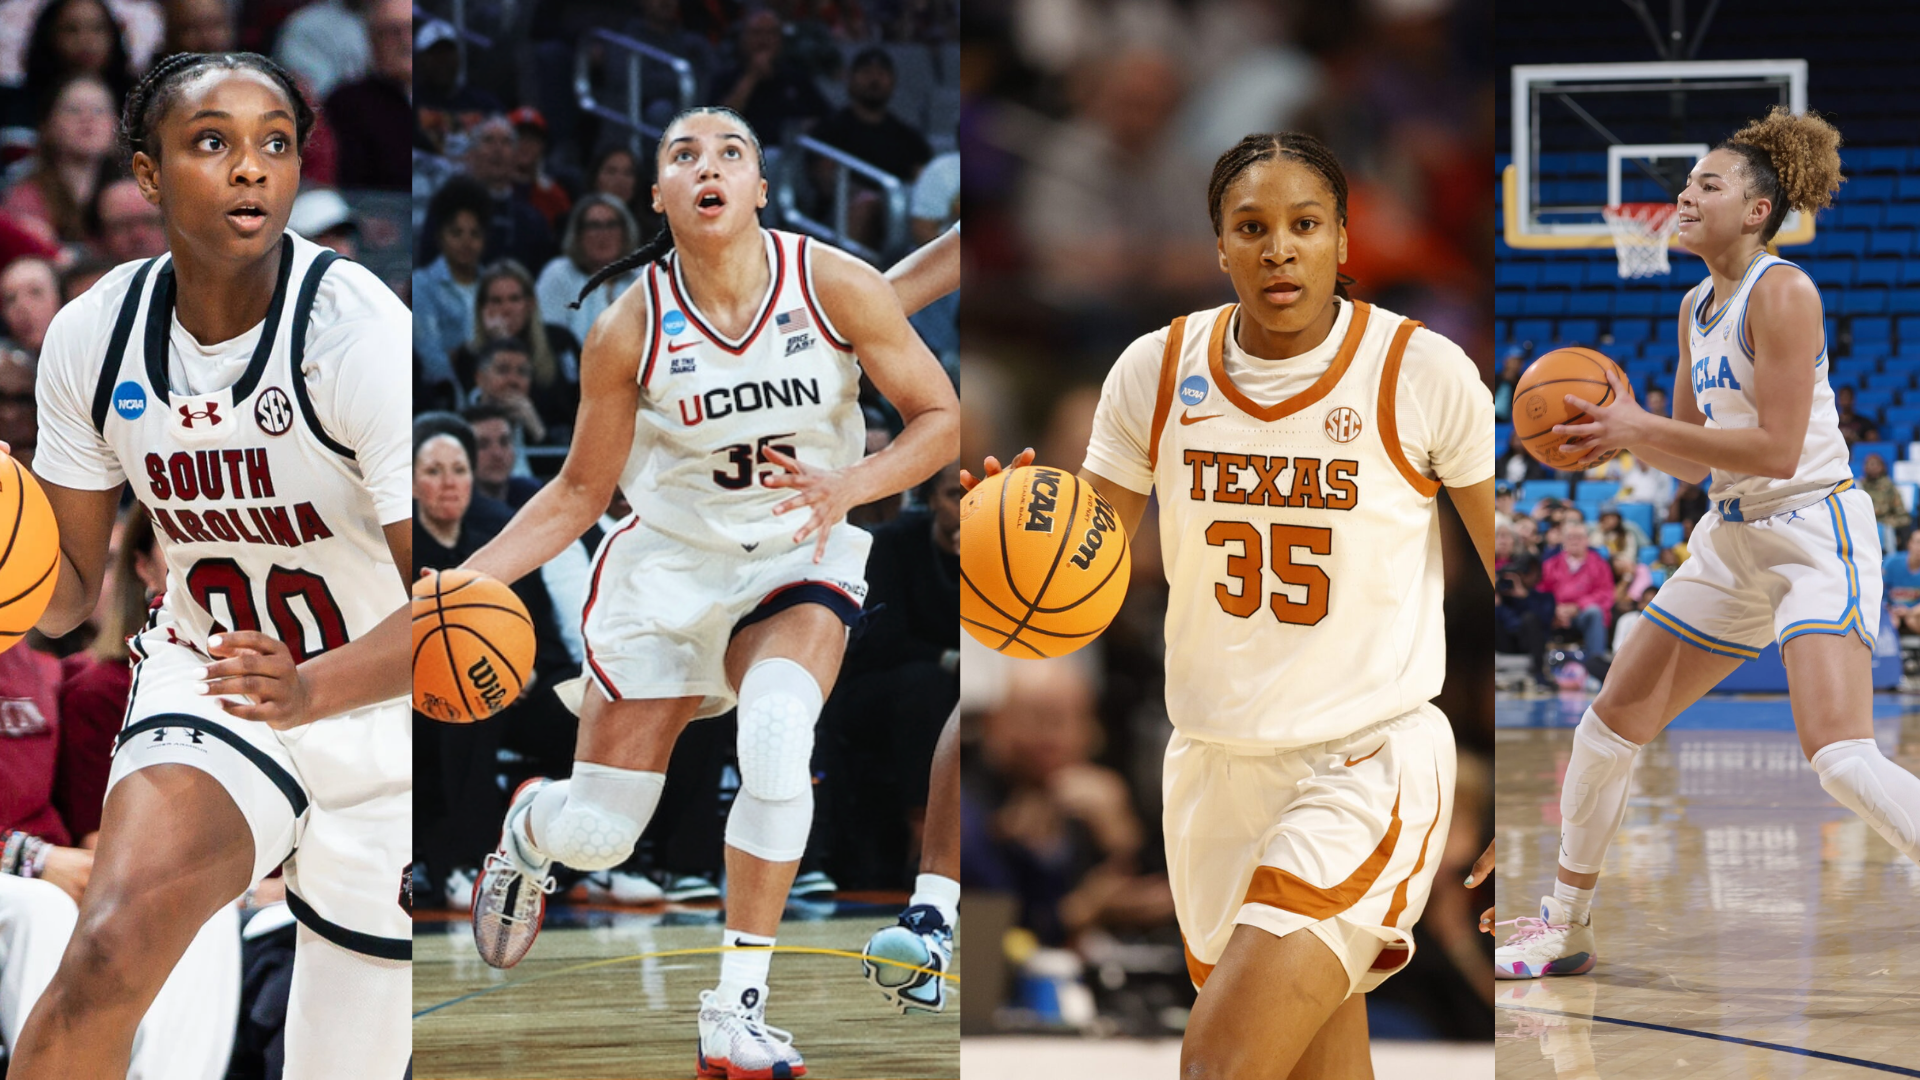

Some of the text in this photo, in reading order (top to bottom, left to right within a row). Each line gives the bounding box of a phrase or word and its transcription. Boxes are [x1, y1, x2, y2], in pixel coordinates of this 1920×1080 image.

[118, 398, 146, 411] NCAA
[257, 389, 291, 433] SEC
[679, 378, 821, 427] UCONN
[1181, 387, 1206, 400] NCAA
[1326, 408, 1362, 443] SEC
[145, 447, 276, 502] SOUTH
[1183, 448, 1359, 511] TEXAS
[1024, 468, 1062, 533] NCAA
[1204, 520, 1333, 627] 35
